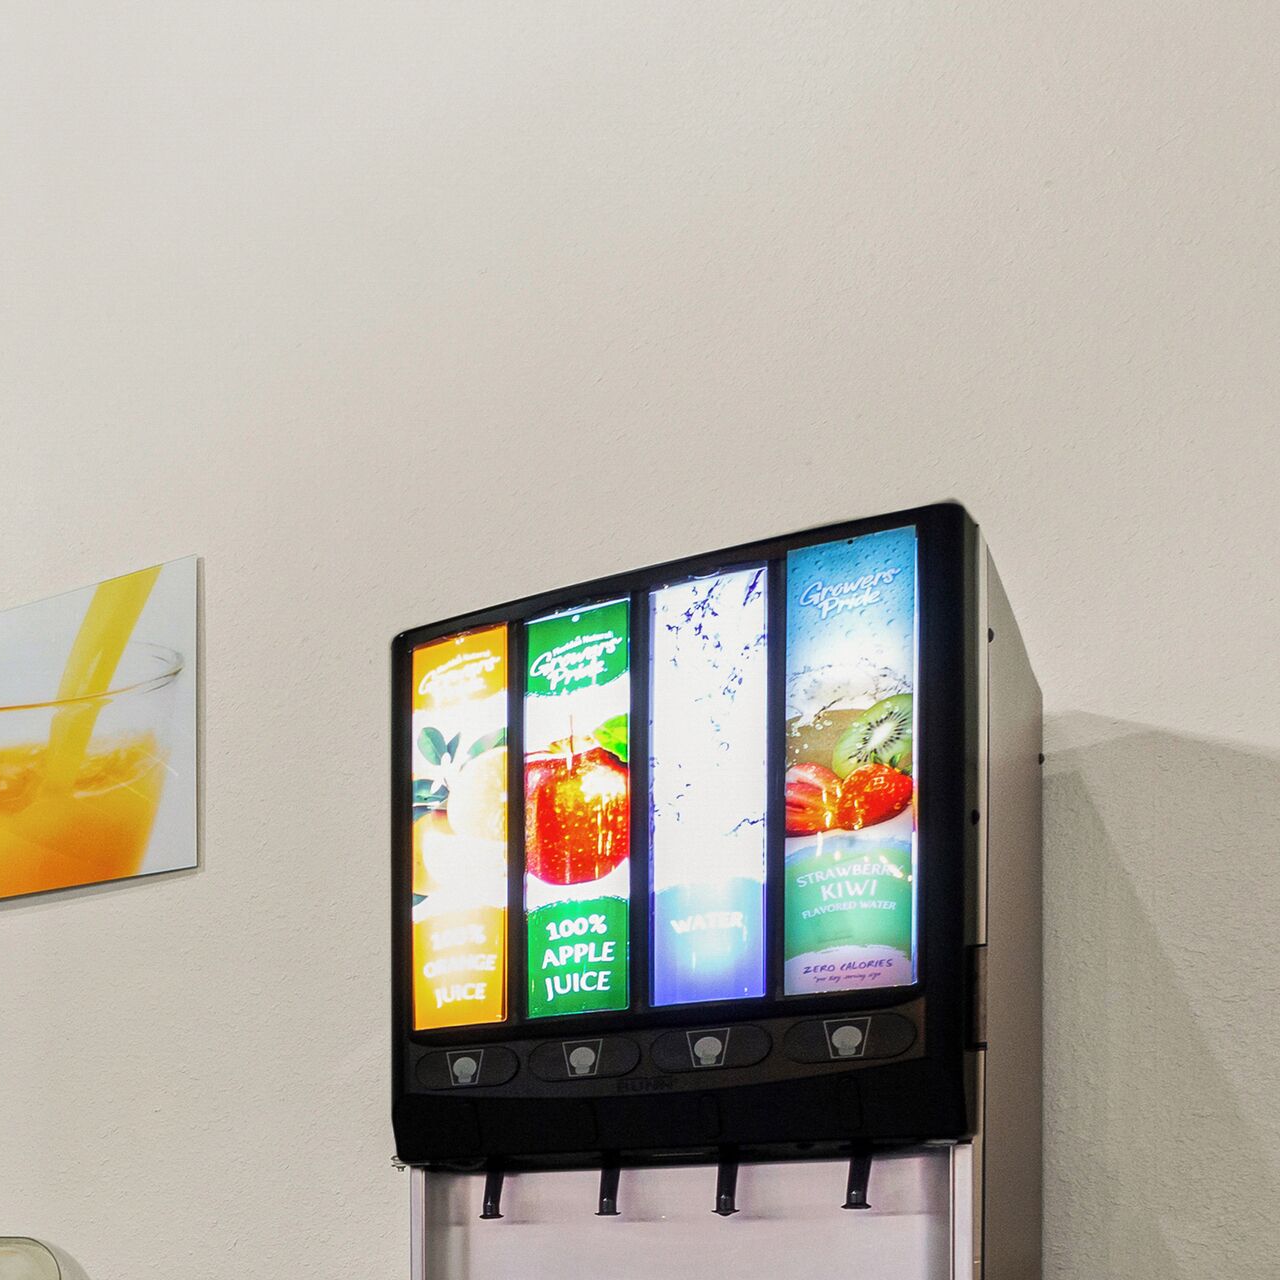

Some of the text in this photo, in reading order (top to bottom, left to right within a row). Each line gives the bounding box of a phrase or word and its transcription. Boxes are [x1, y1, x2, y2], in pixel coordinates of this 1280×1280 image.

[800, 567, 900, 607] Growers
[818, 586, 881, 621] Pride
[530, 637, 623, 677] Growers
[820, 879, 878, 901] KIWI
[801, 900, 897, 920] FLAVORED WATER
[545, 913, 608, 941] 100%
[541, 941, 616, 969] APPLE
[803, 958, 893, 975] ZERO CALORIES
[434, 982, 487, 1009] JUICE
[545, 970, 612, 1002] JUICE
